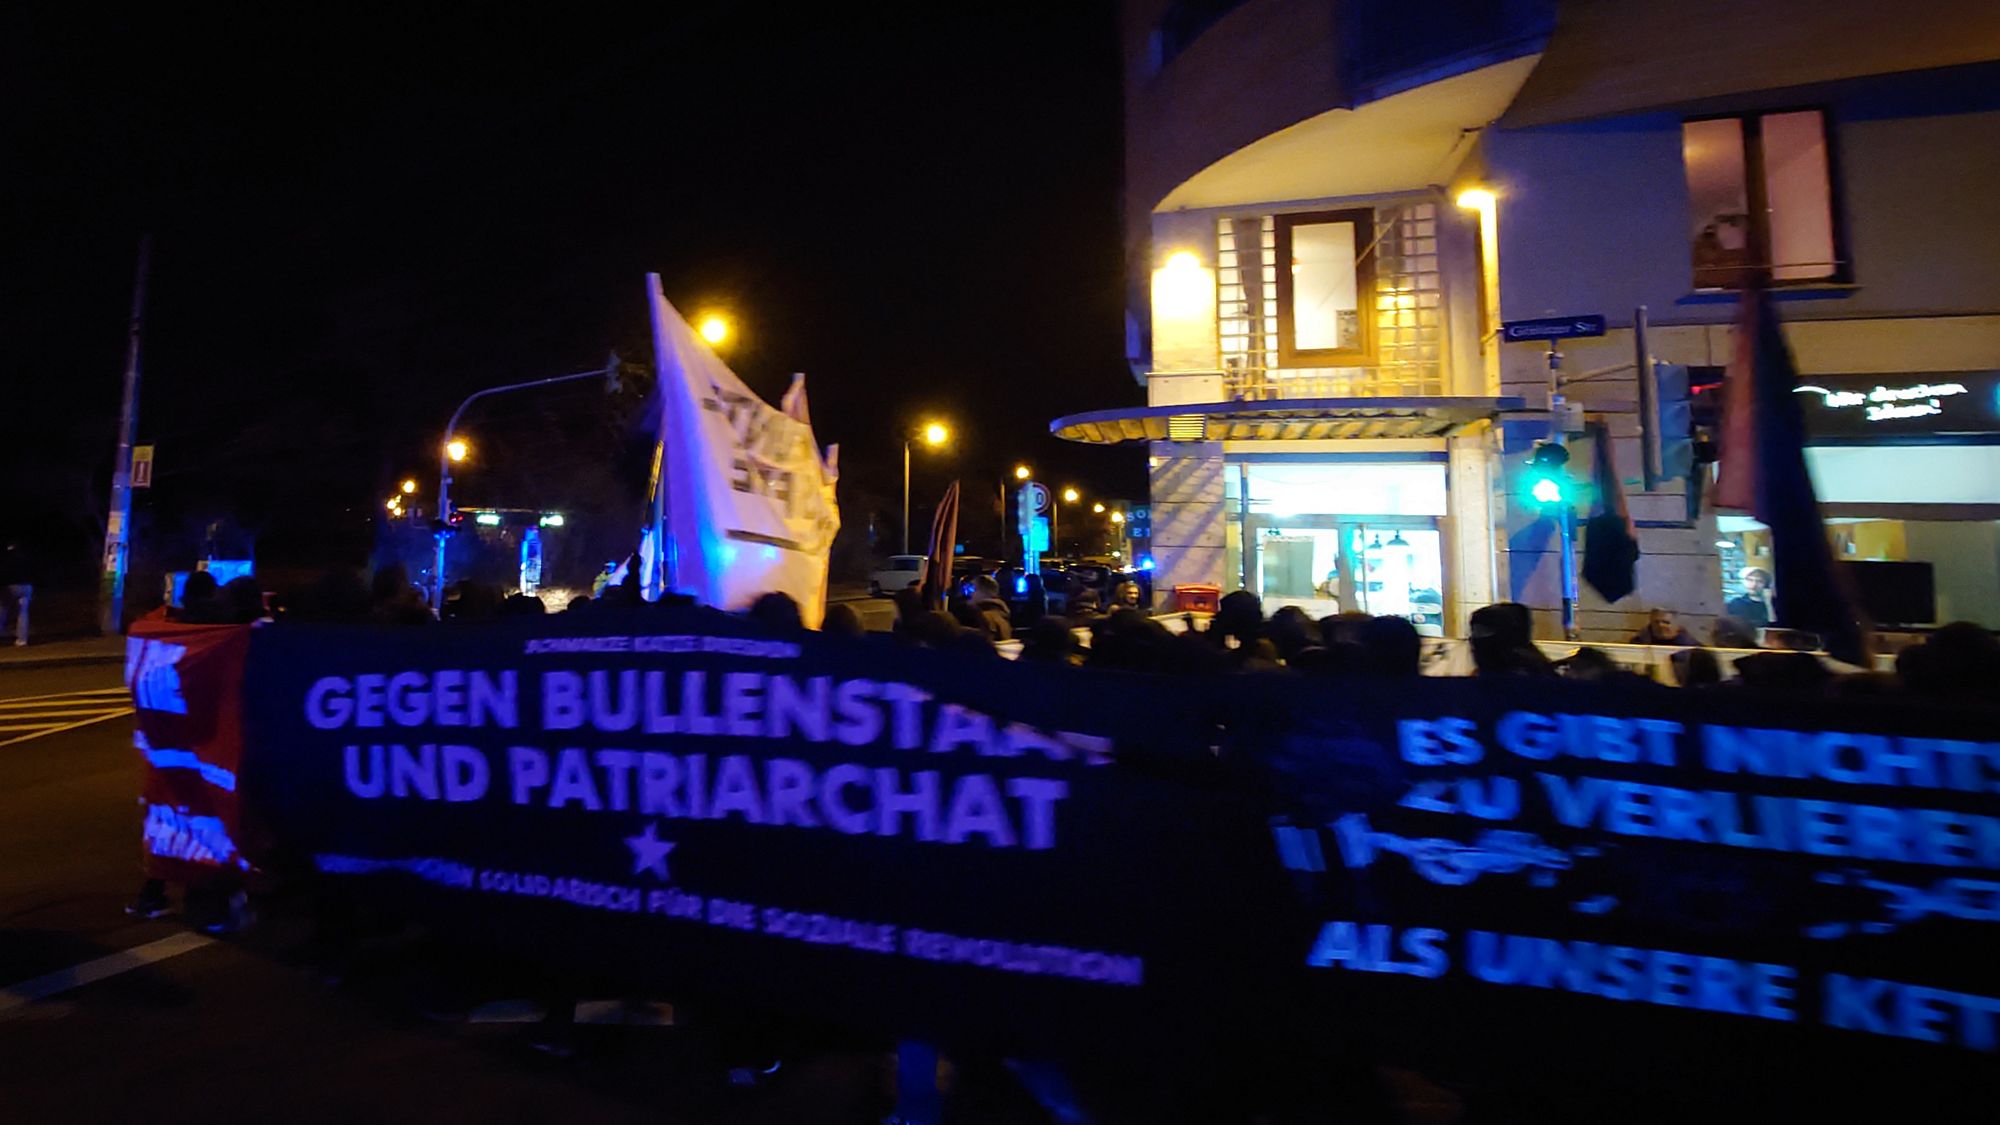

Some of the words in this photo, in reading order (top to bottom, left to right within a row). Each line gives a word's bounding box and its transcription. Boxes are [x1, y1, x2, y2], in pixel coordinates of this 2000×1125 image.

[304, 669, 519, 730] GEGEN
[1397, 716, 1484, 766] ES
[1496, 710, 1686, 767] GIBT
[343, 743, 490, 803] UND
[507, 745, 1070, 850] PATRIARCHAT
[1397, 775, 1522, 821] ZU
[479, 869, 641, 913] SOLIDARISCH
[1305, 920, 1450, 979] ALS
[1463, 929, 1799, 1022] UNSERE
